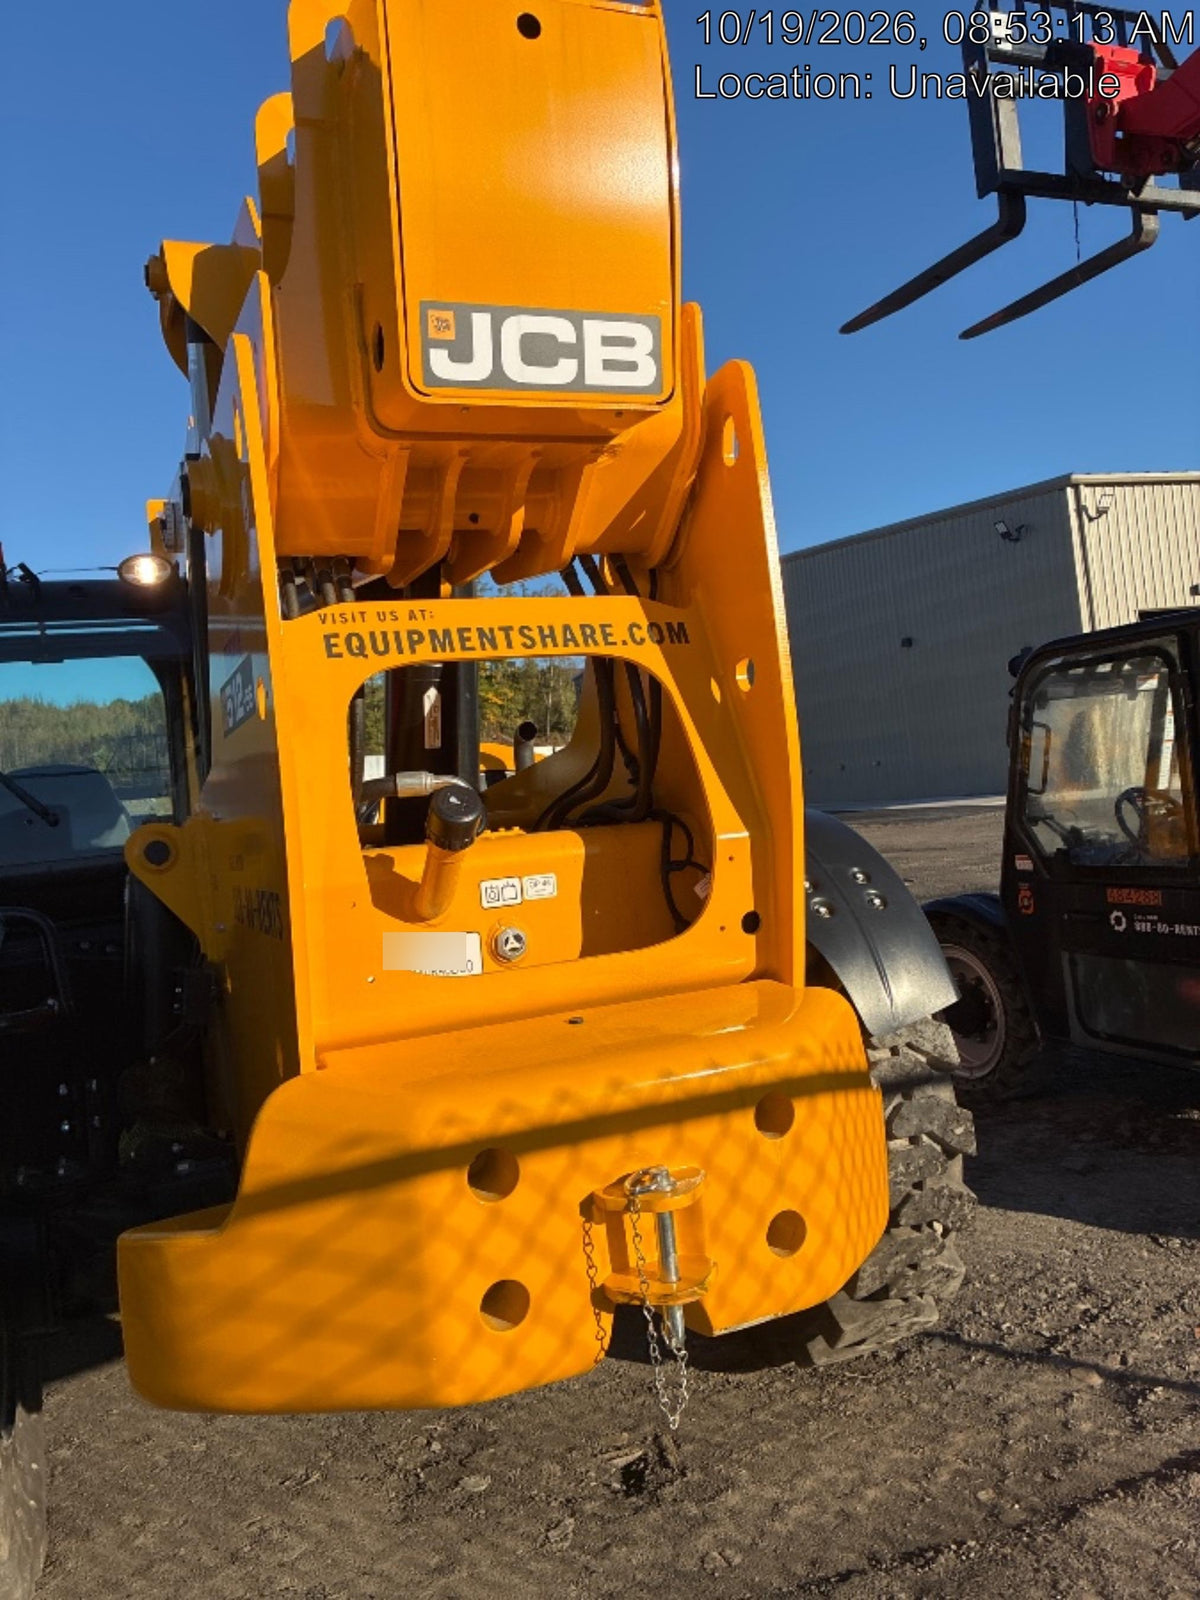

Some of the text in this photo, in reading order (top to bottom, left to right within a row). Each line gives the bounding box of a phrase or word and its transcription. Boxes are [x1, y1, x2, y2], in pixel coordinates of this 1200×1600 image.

[429, 312, 657, 387] JCB
[319, 608, 434, 625] VISIT US AT:
[323, 620, 691, 660] EQUIPMENTSHARE.COM
